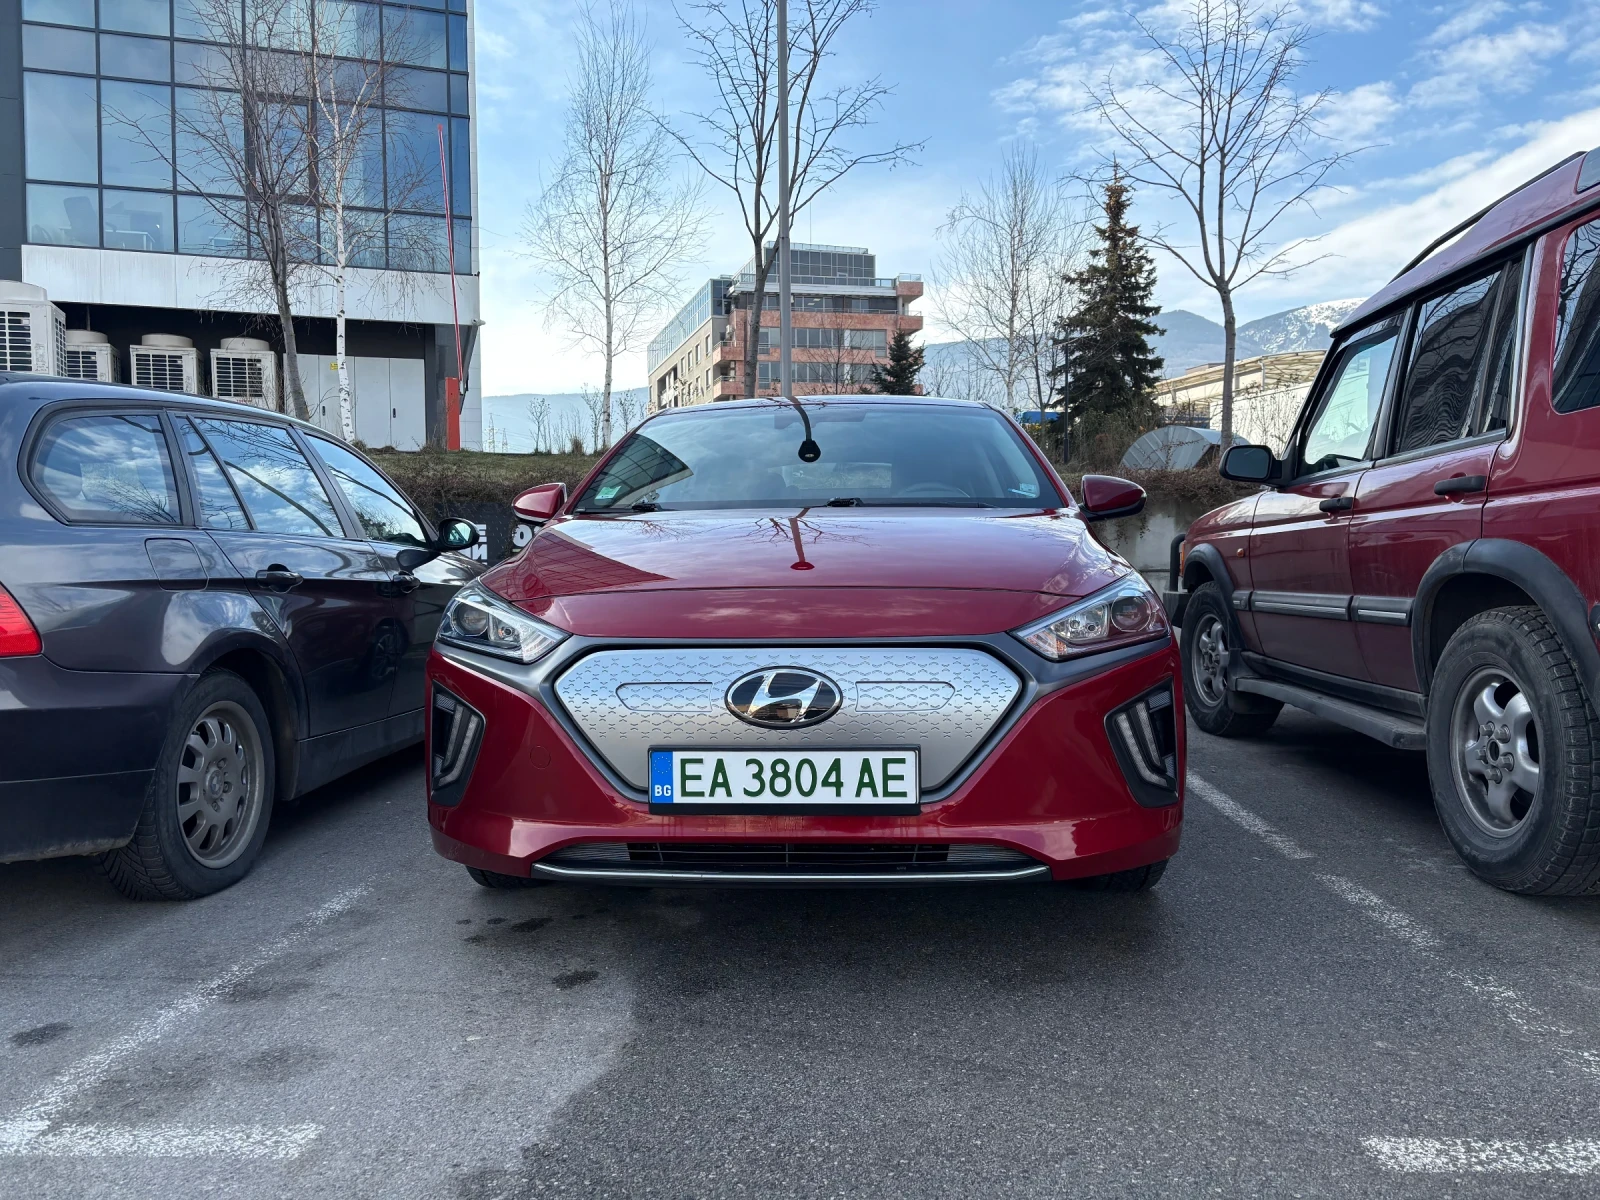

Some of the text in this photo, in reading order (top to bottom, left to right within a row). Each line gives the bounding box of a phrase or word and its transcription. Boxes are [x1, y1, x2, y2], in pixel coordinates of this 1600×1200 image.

[654, 784, 672, 797] BG
[680, 758, 908, 797] EA 3804 AE
